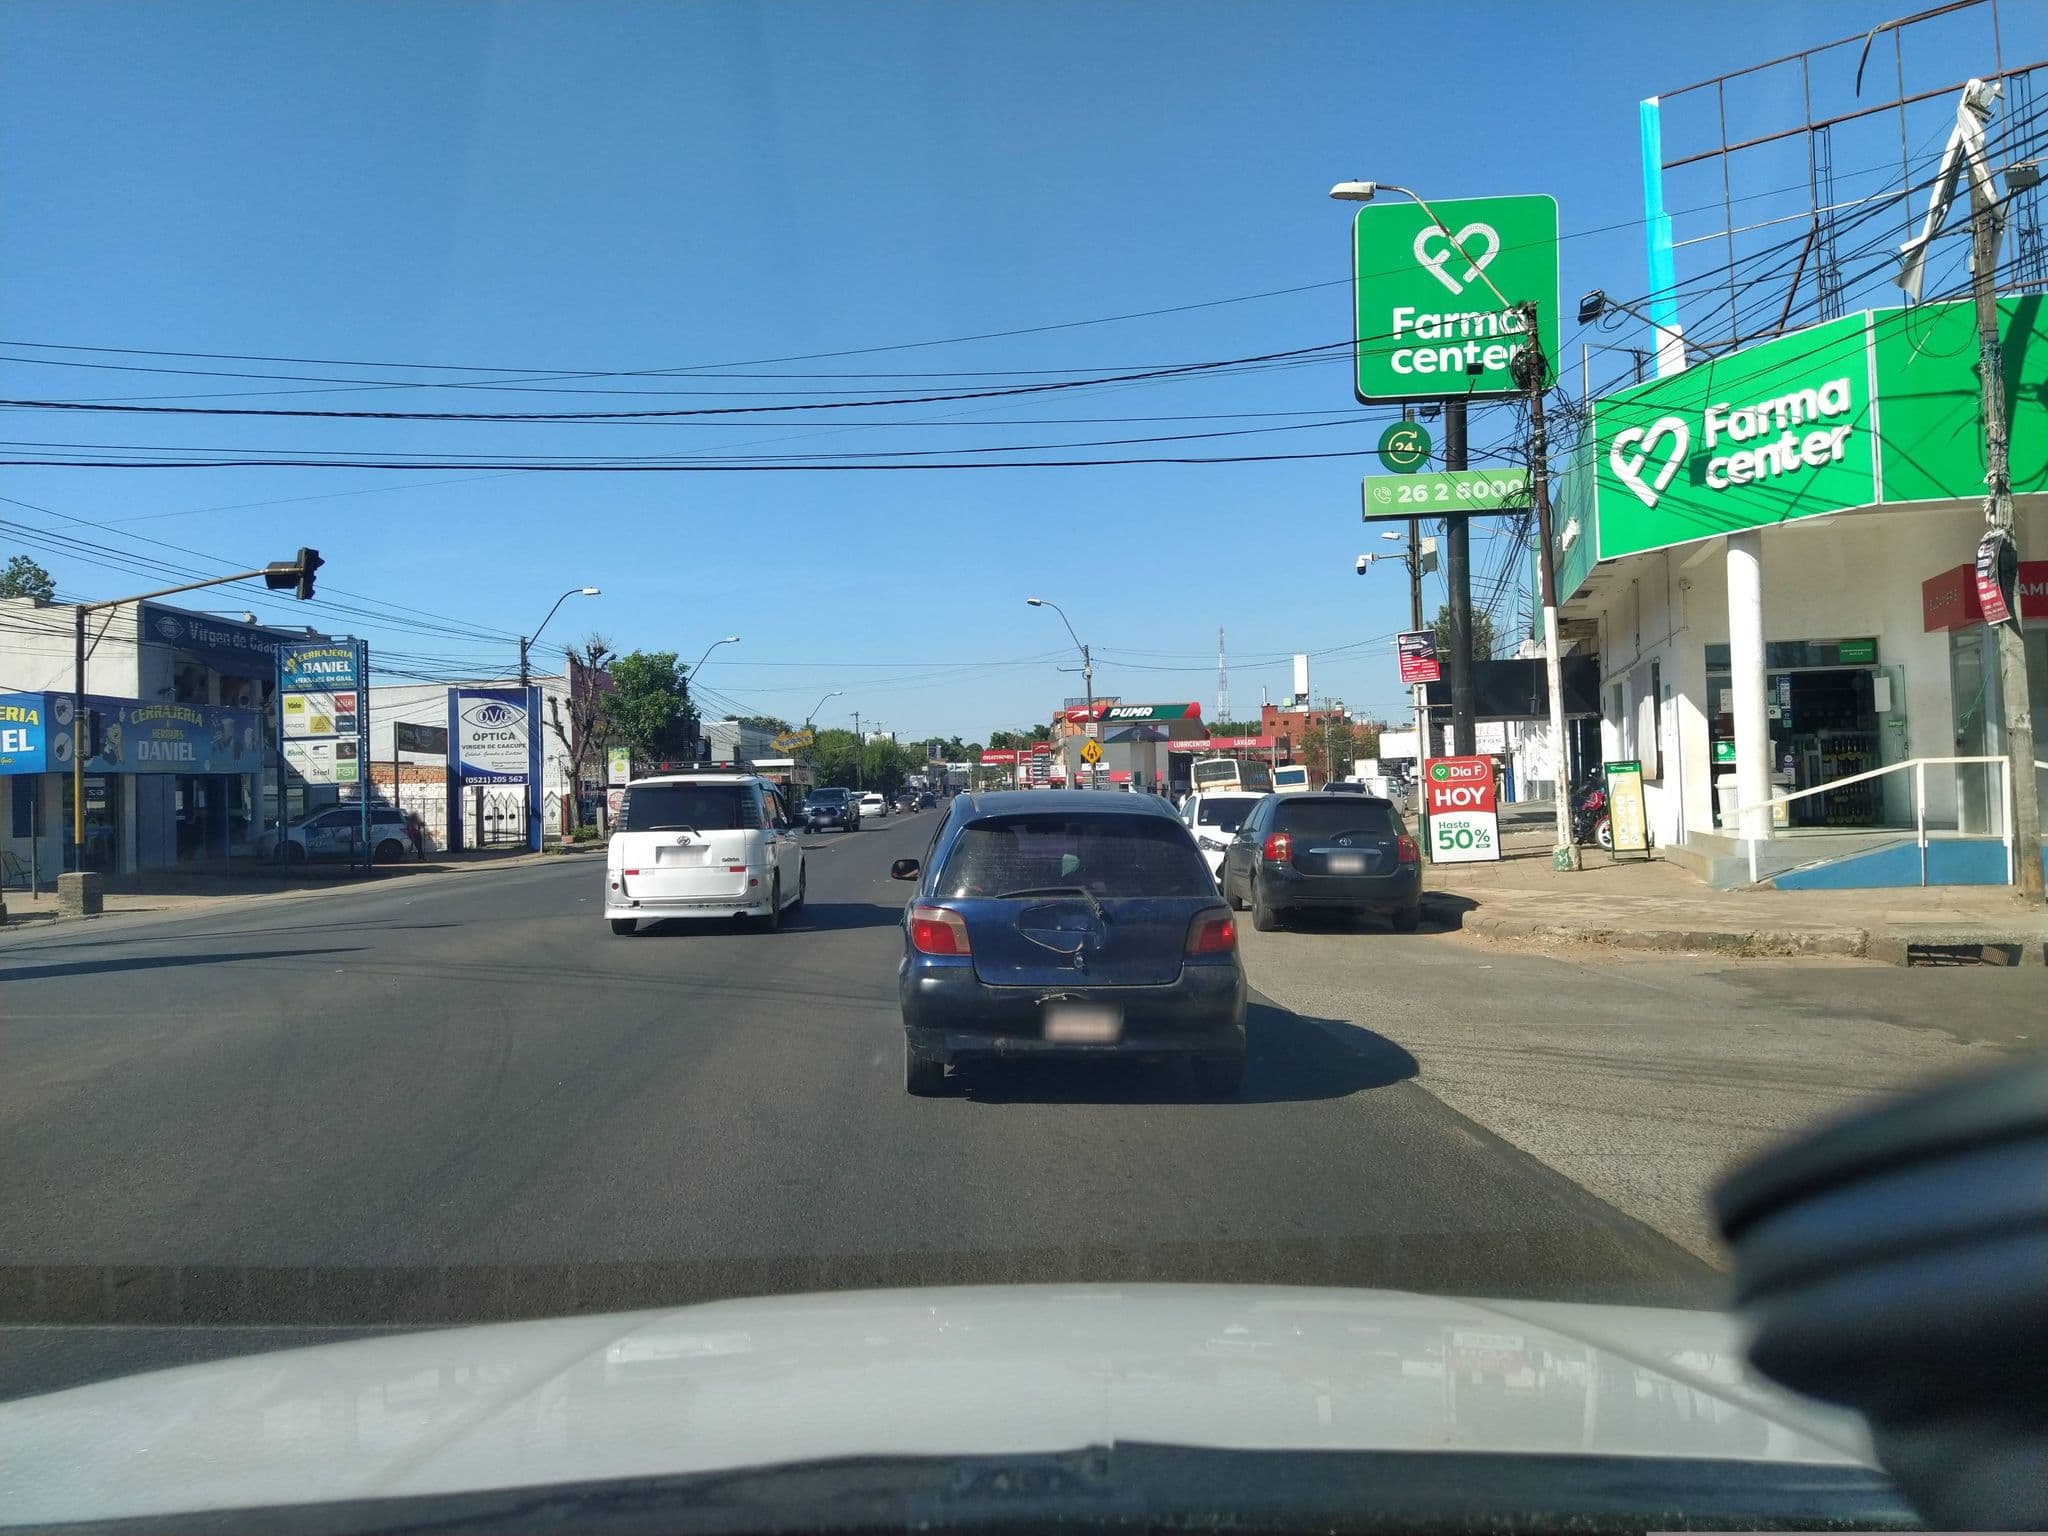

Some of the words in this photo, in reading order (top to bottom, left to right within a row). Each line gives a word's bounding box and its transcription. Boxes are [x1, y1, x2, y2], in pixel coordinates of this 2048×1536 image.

[1393, 307, 1526, 340] Farma
[1705, 378, 1850, 448] Farma
[1706, 424, 1852, 489] center
[1398, 485, 1428, 503] 26
[1435, 483, 1449, 501] 2
[189, 621, 231, 648] Virgen
[233, 632, 246, 649] de
[303, 661, 352, 674] DANIEL
[1109, 707, 1153, 718] PUMA
[138, 740, 197, 761] DANIEL
[465, 776, 491, 784] (0521)
[508, 775, 524, 783] 562
[1474, 765, 1482, 776] F
[1435, 786, 1486, 807] HOY
[1439, 821, 1470, 829] Hasta
